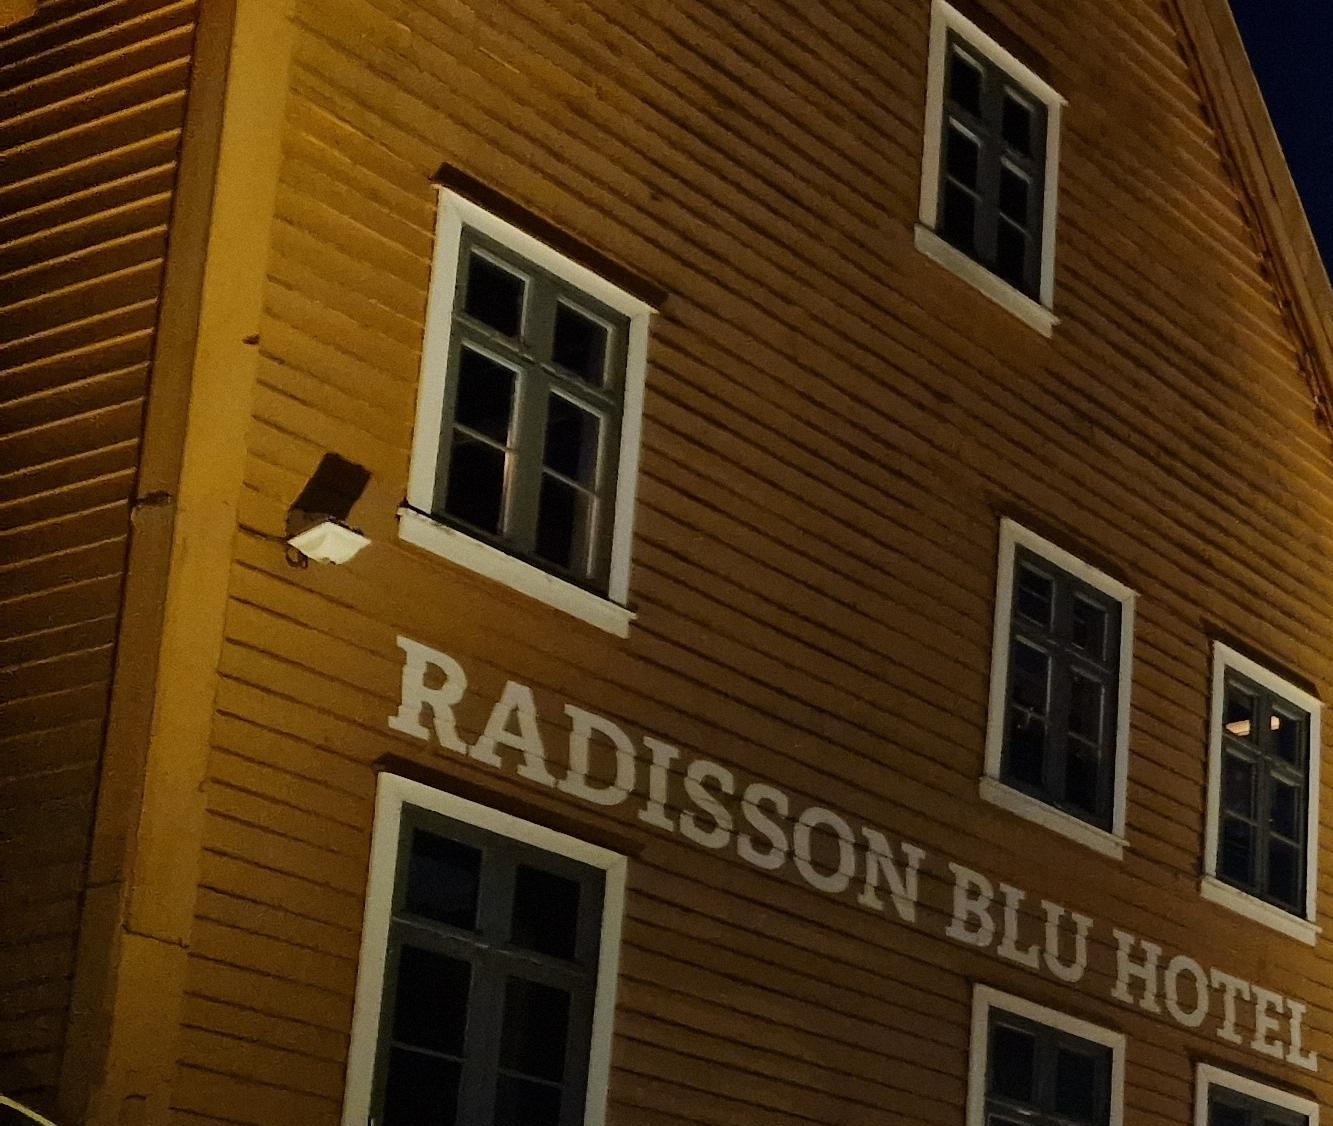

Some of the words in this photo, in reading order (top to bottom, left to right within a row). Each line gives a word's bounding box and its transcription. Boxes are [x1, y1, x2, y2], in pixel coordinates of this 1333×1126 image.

[387, 635, 926, 923] RADISSON
[945, 861, 1094, 983] BLU
[1110, 928, 1319, 1072] HOTEL
